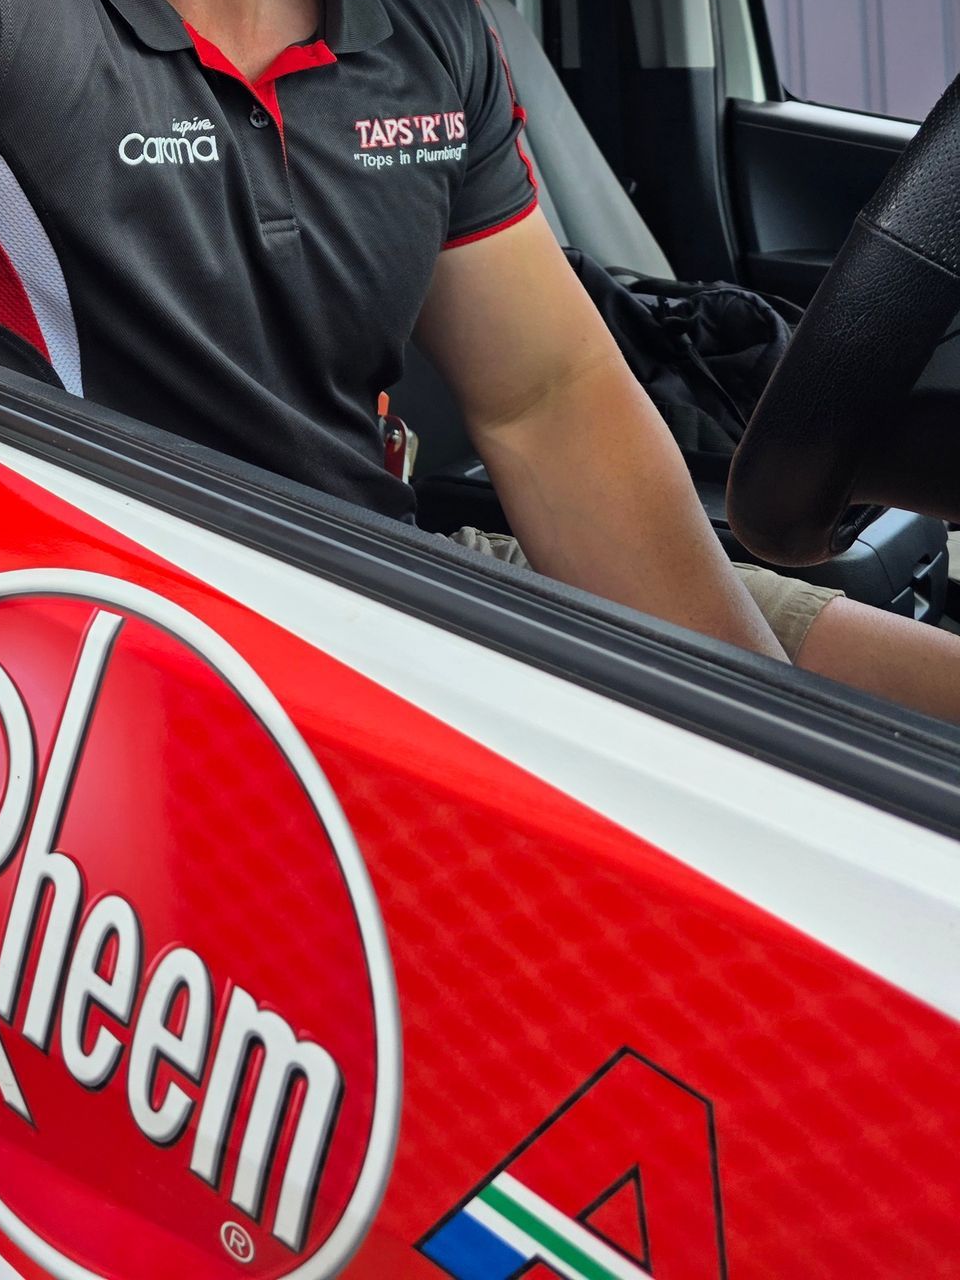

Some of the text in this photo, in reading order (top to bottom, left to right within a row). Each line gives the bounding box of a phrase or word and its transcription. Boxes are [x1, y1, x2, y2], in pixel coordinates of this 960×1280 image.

[171, 116, 215, 137] inspire
[355, 117, 414, 148] TAPS
[443, 110, 465, 141] US
[399, 149, 411, 165] in
